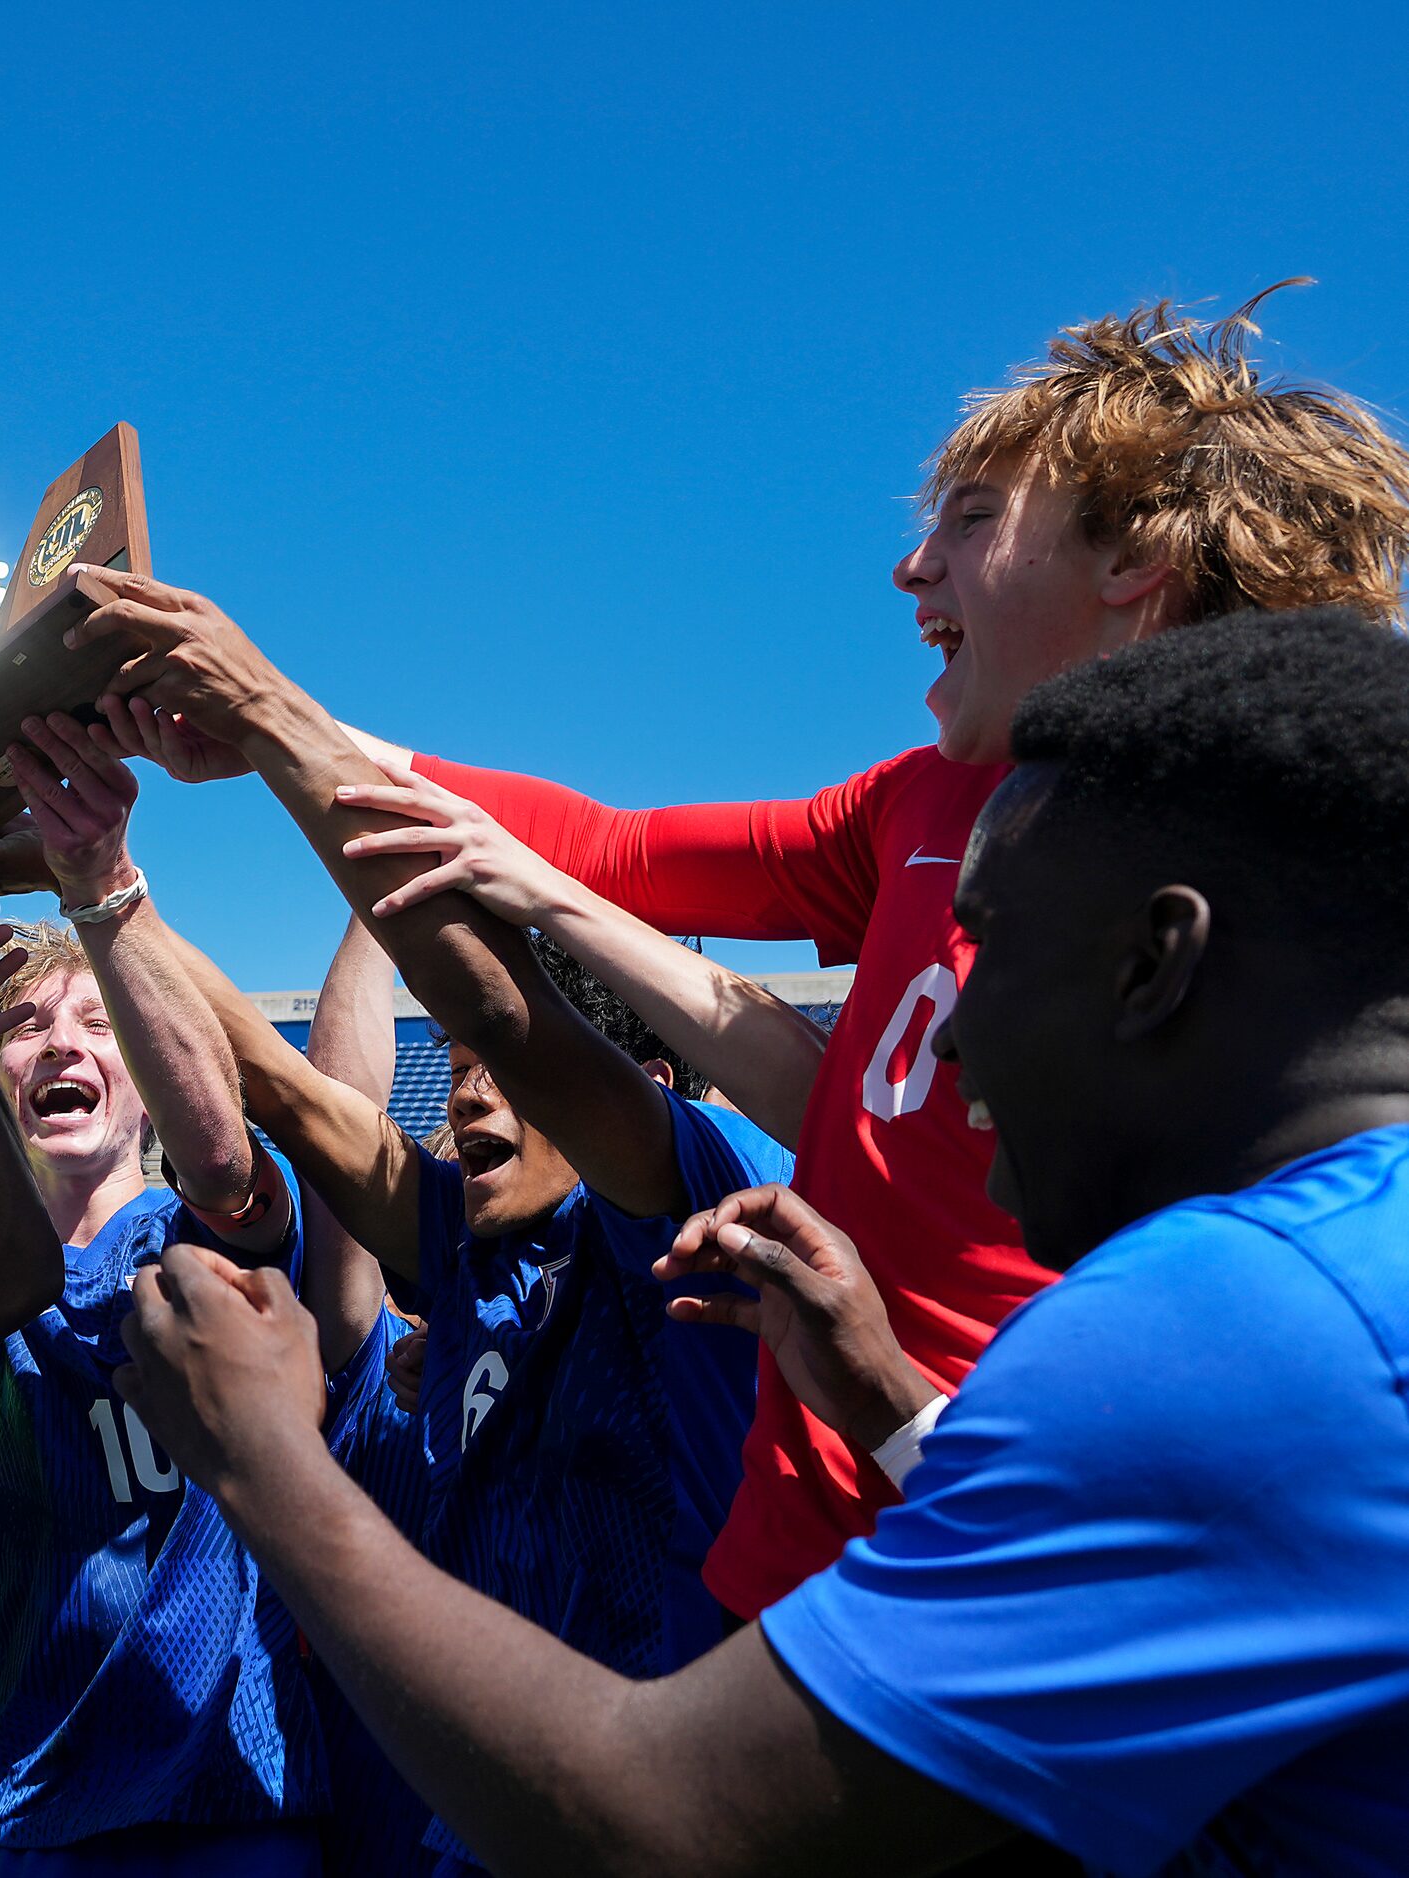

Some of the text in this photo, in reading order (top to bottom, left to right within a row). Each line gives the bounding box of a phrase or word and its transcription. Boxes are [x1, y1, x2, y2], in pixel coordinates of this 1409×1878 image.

[293, 998, 317, 1011] 215
[862, 963, 958, 1123] 0
[461, 1351, 509, 1454] 6
